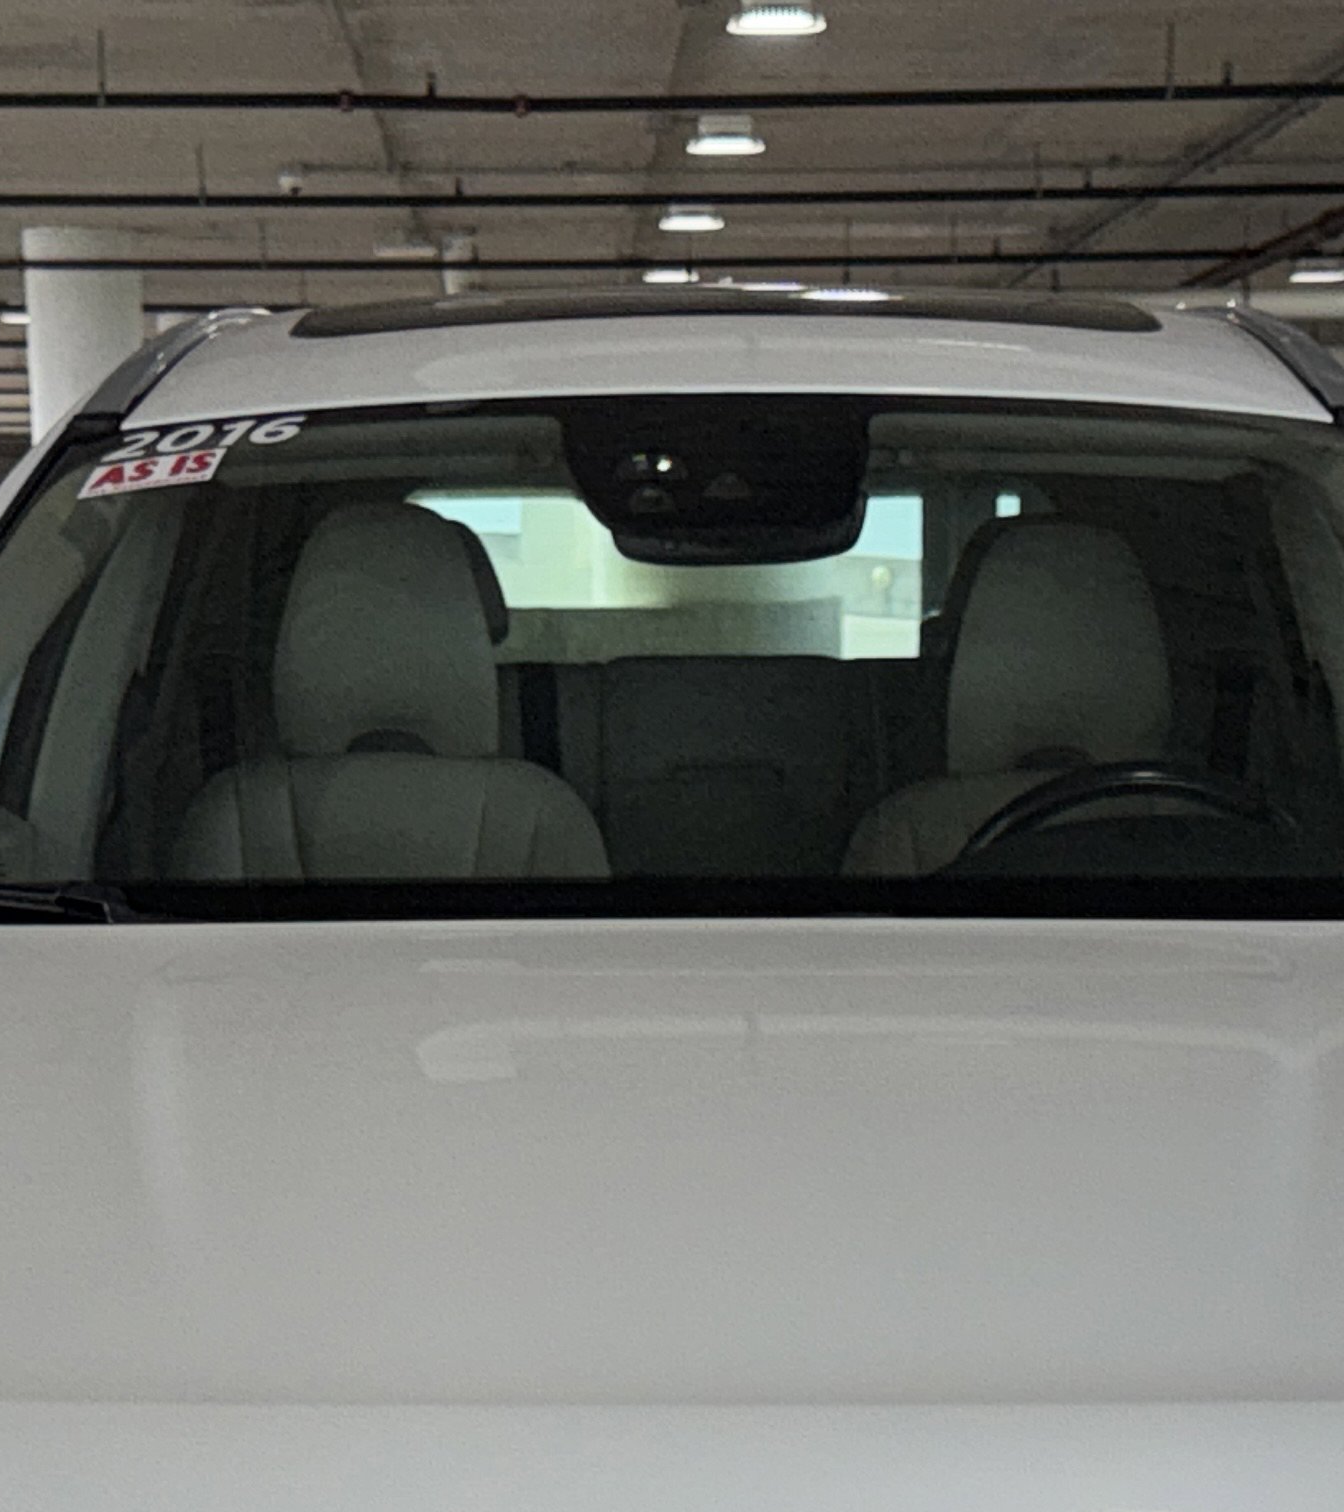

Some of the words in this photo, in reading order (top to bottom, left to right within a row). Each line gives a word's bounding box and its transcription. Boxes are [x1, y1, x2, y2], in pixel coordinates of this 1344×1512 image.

[102, 417, 306, 461] 2016
[90, 461, 156, 489] AS
[170, 453, 214, 477] IS
